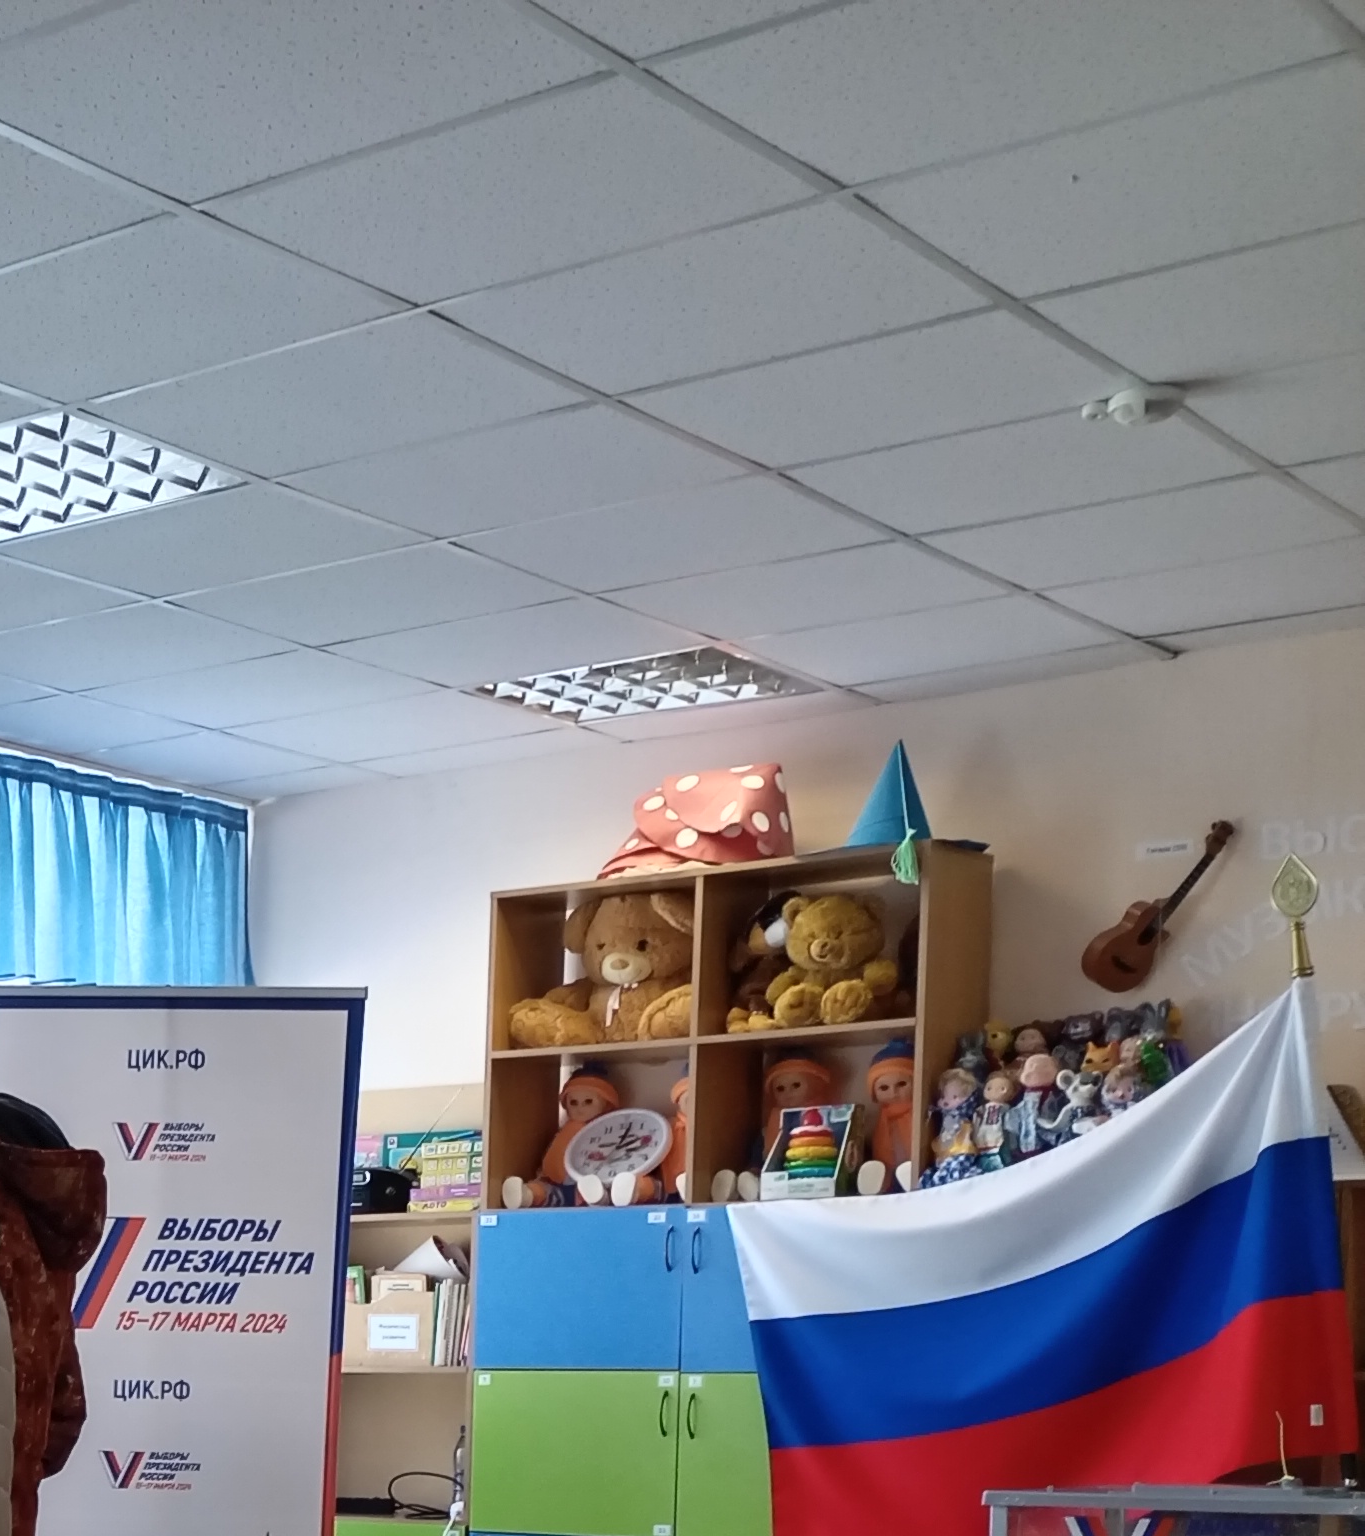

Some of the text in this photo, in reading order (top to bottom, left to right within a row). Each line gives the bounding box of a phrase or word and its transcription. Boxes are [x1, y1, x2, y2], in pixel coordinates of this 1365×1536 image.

[126, 1048, 206, 1072] ЦИК.РФ
[157, 1133, 216, 1143] ПРЕЗИДЕНТА
[162, 1122, 205, 1132] ВЫБОРЫ
[152, 1143, 191, 1153] РОССИИ
[158, 1218, 282, 1243] ВЫБОРЫ
[141, 1250, 315, 1277] ПРЕЗИДЕНТА
[126, 1281, 241, 1306] РОССИИ
[115, 1311, 289, 1335] 15–17 МАРТА 2024
[113, 1378, 191, 1402] ЦИК.РФ
